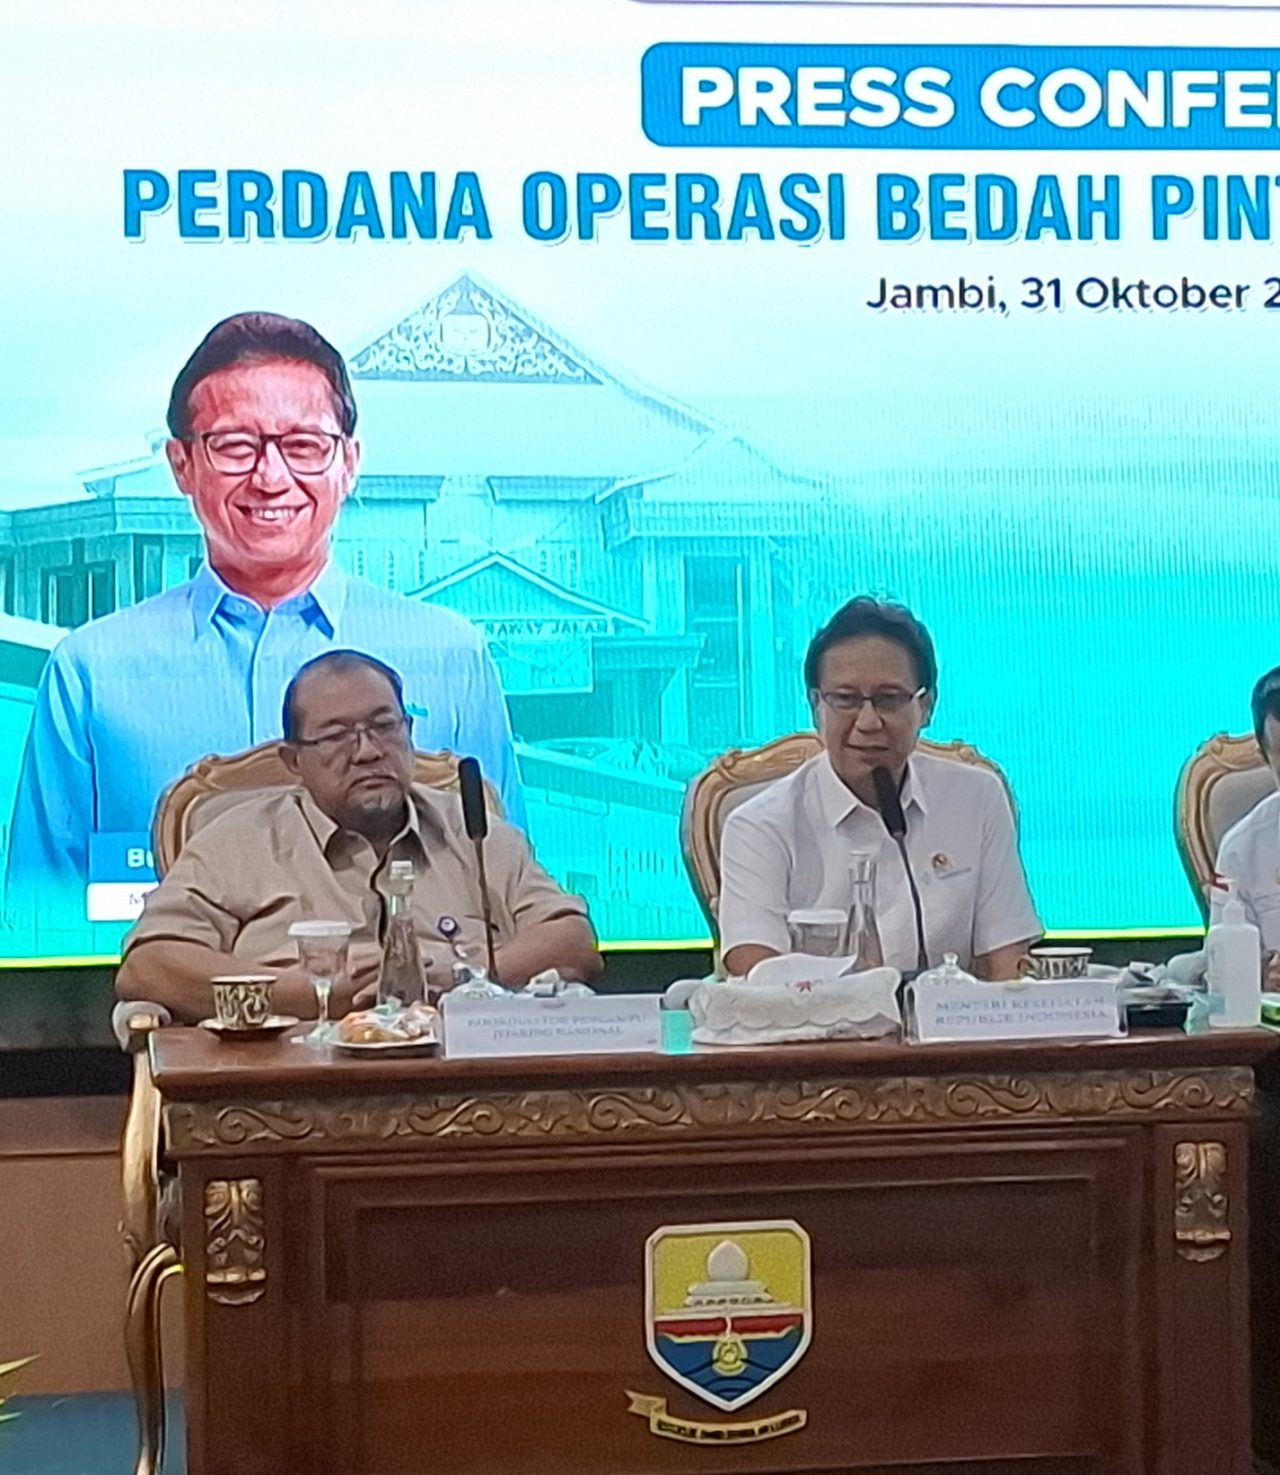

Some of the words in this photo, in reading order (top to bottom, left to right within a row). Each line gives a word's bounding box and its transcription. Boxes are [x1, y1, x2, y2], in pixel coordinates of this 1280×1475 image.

[682, 67, 954, 128] PRESS
[122, 170, 493, 241] PERDANA
[522, 171, 847, 244] OPERASI
[876, 173, 1121, 242] BEDAH
[866, 275, 1008, 312] Jambi,
[1020, 277, 1061, 309] 31
[1075, 276, 1251, 310] Oktober
